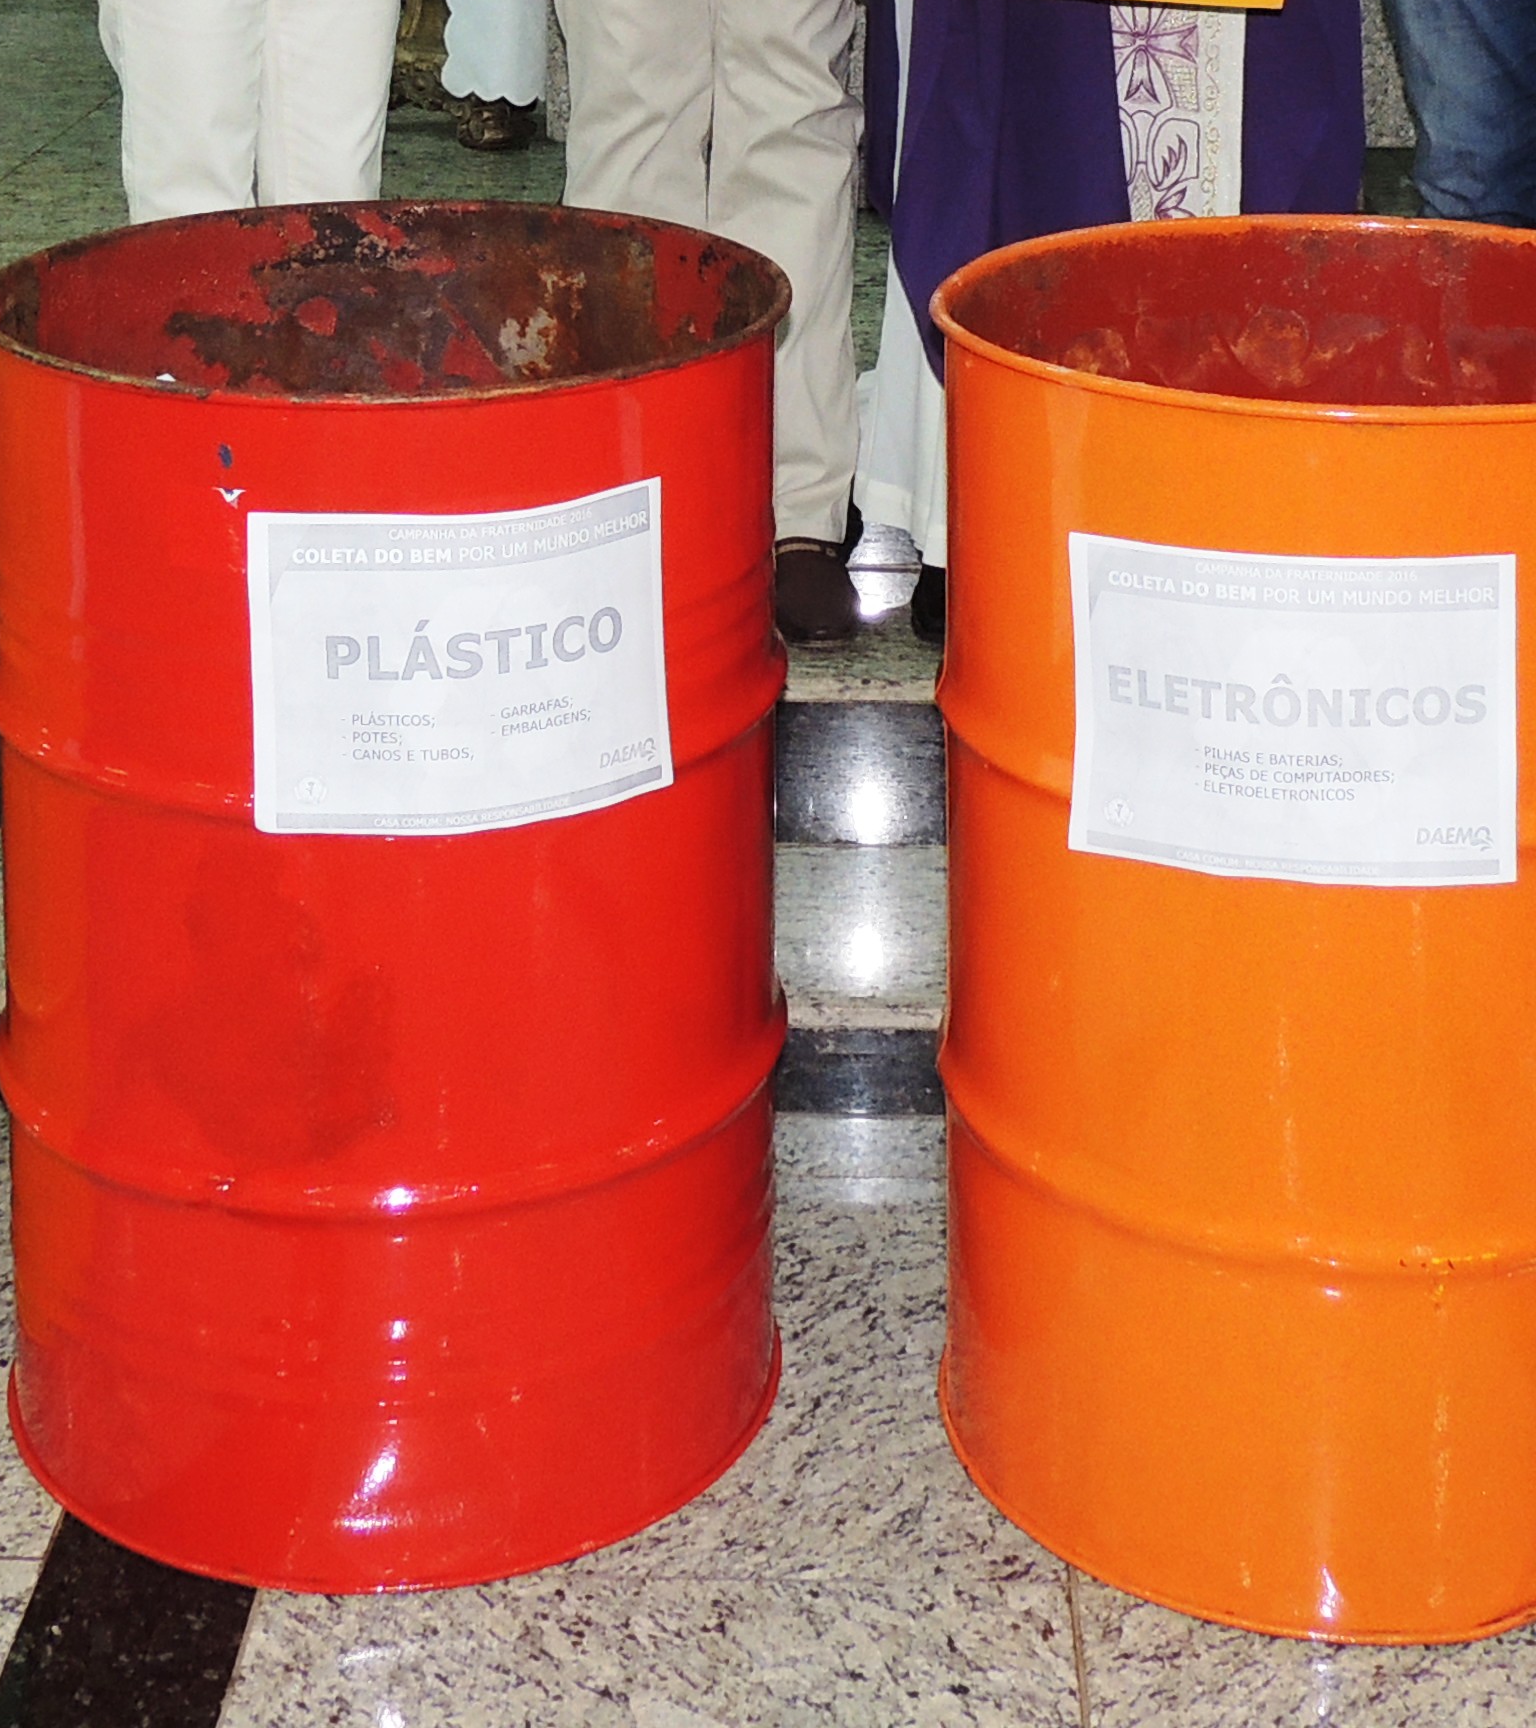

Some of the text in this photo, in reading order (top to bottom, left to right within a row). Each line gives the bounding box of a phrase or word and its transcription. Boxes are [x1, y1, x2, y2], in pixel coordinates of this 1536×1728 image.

[389, 507, 593, 541] CAMPANHA DA FRATERNIDADE 2016
[292, 510, 648, 565] COLETA DO BEM POR UM MUNDO MELHOR
[1195, 562, 1418, 583] CAMPANHA DA FRATERNIDADE 2016
[1107, 570, 1495, 606] COLETA DO BEM POR UM MUNDO MELHOR
[325, 606, 622, 681] PLÁSTICO
[500, 695, 576, 720] GARRAFAS;
[1107, 664, 1488, 728] ELETRÔNICOS
[351, 711, 436, 729] PLÁSTICOS;
[501, 708, 592, 737] EMBALAGENS;
[352, 732, 404, 747] POTES;
[352, 748, 402, 762] CANOS
[407, 748, 416, 762] E
[1204, 745, 1343, 768] PILHAS E BATERIAS;
[1204, 762, 1396, 785] PEÇAS DE COMPUTADORES;
[374, 817, 400, 827] CASA
[445, 814, 478, 825] NOSSA
[1176, 850, 1201, 862] CASA
